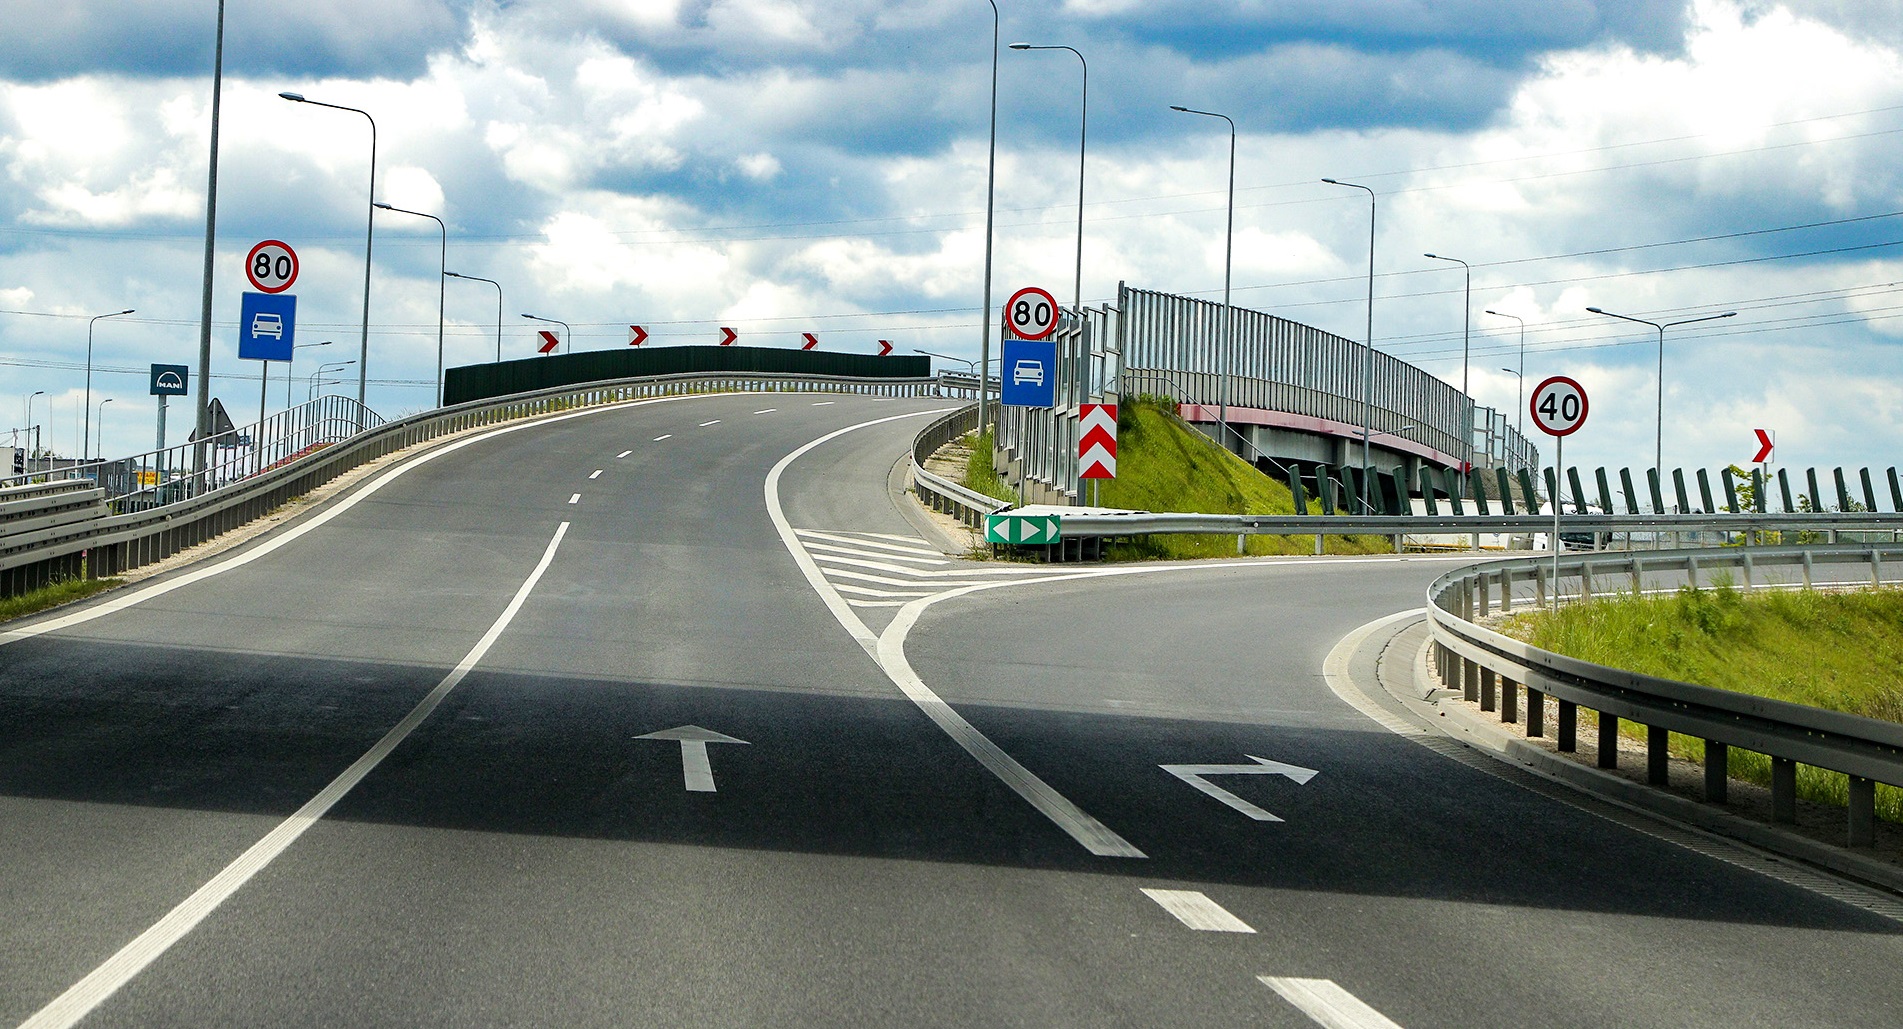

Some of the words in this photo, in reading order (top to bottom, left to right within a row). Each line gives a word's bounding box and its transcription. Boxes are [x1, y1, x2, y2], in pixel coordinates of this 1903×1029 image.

[254, 253, 291, 280] 80
[1014, 301, 1051, 327] 80
[1539, 393, 1580, 421] 40
